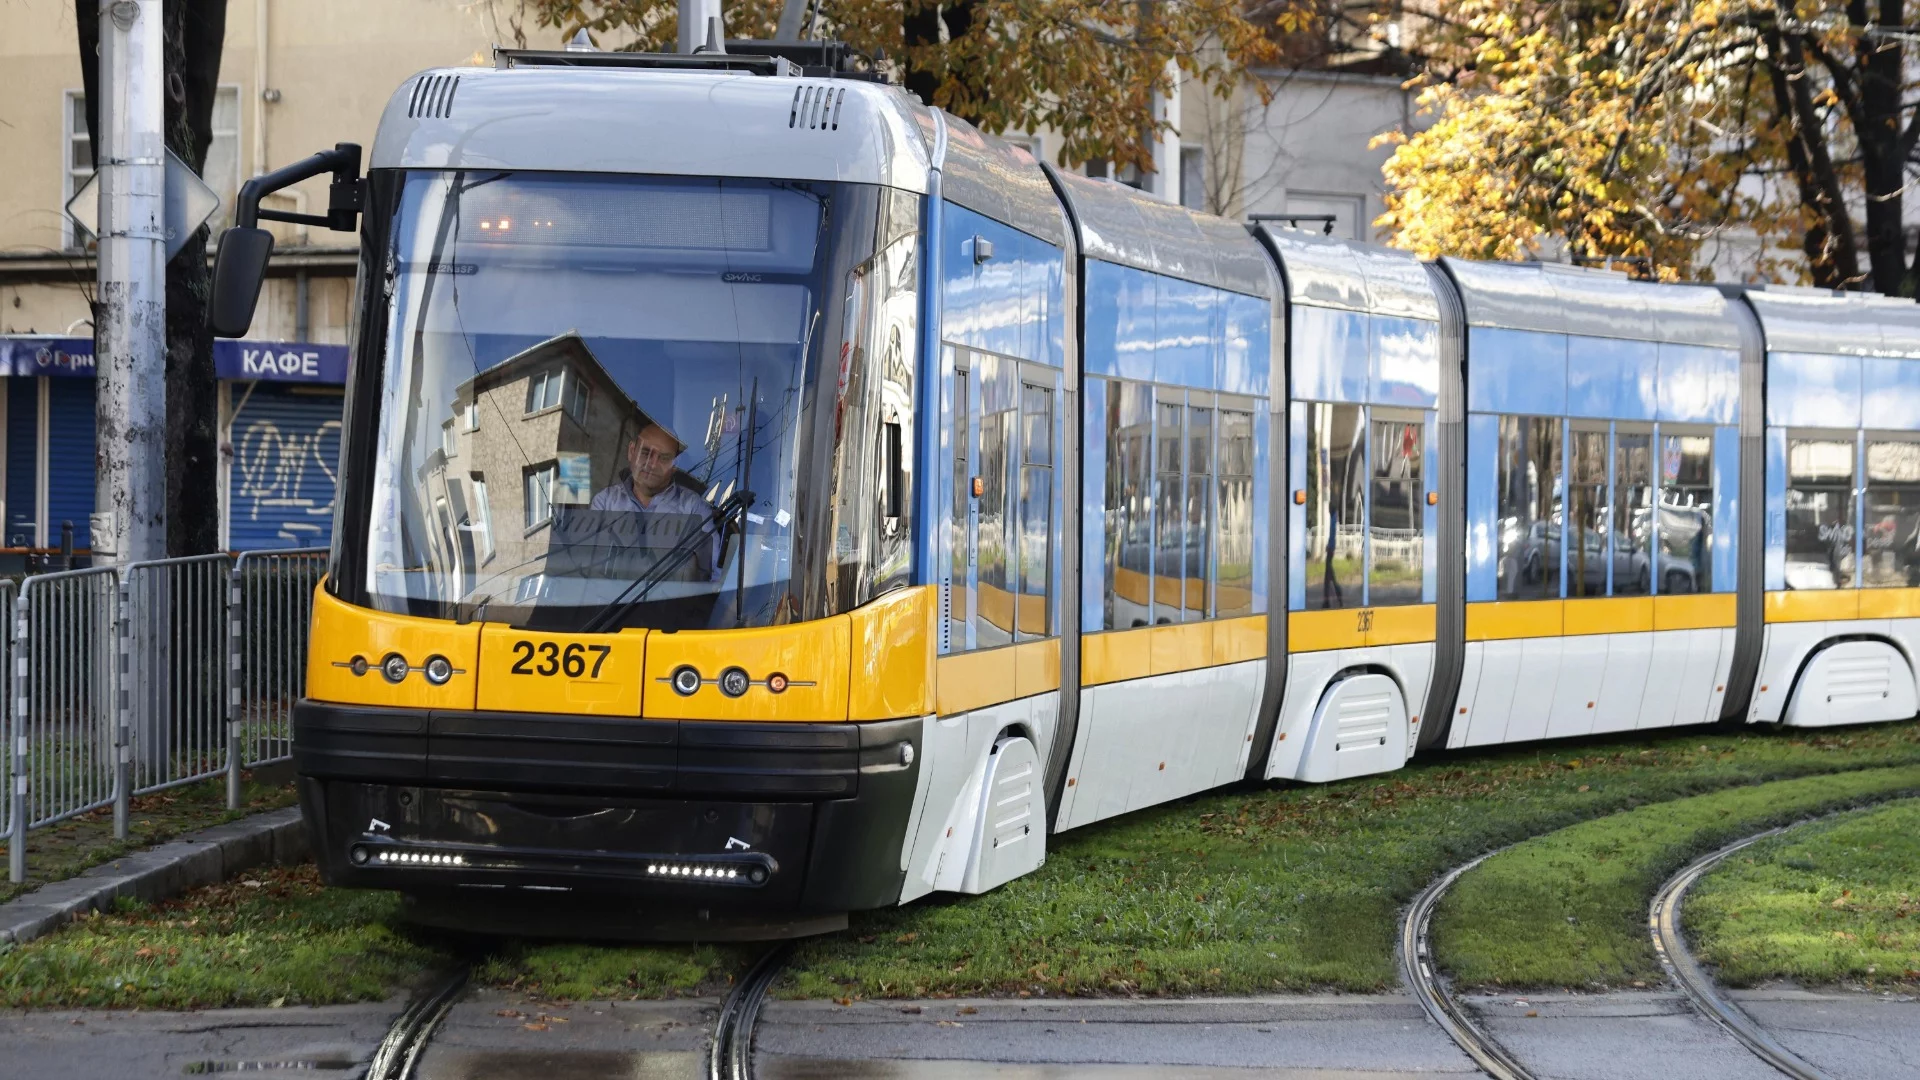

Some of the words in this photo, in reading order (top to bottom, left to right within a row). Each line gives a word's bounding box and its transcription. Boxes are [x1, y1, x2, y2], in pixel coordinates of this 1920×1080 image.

[724, 273, 762, 282] SWING
[243, 349, 319, 376] КАФЕ
[1357, 610, 1374, 632] 2367
[510, 640, 611, 679] 2367
